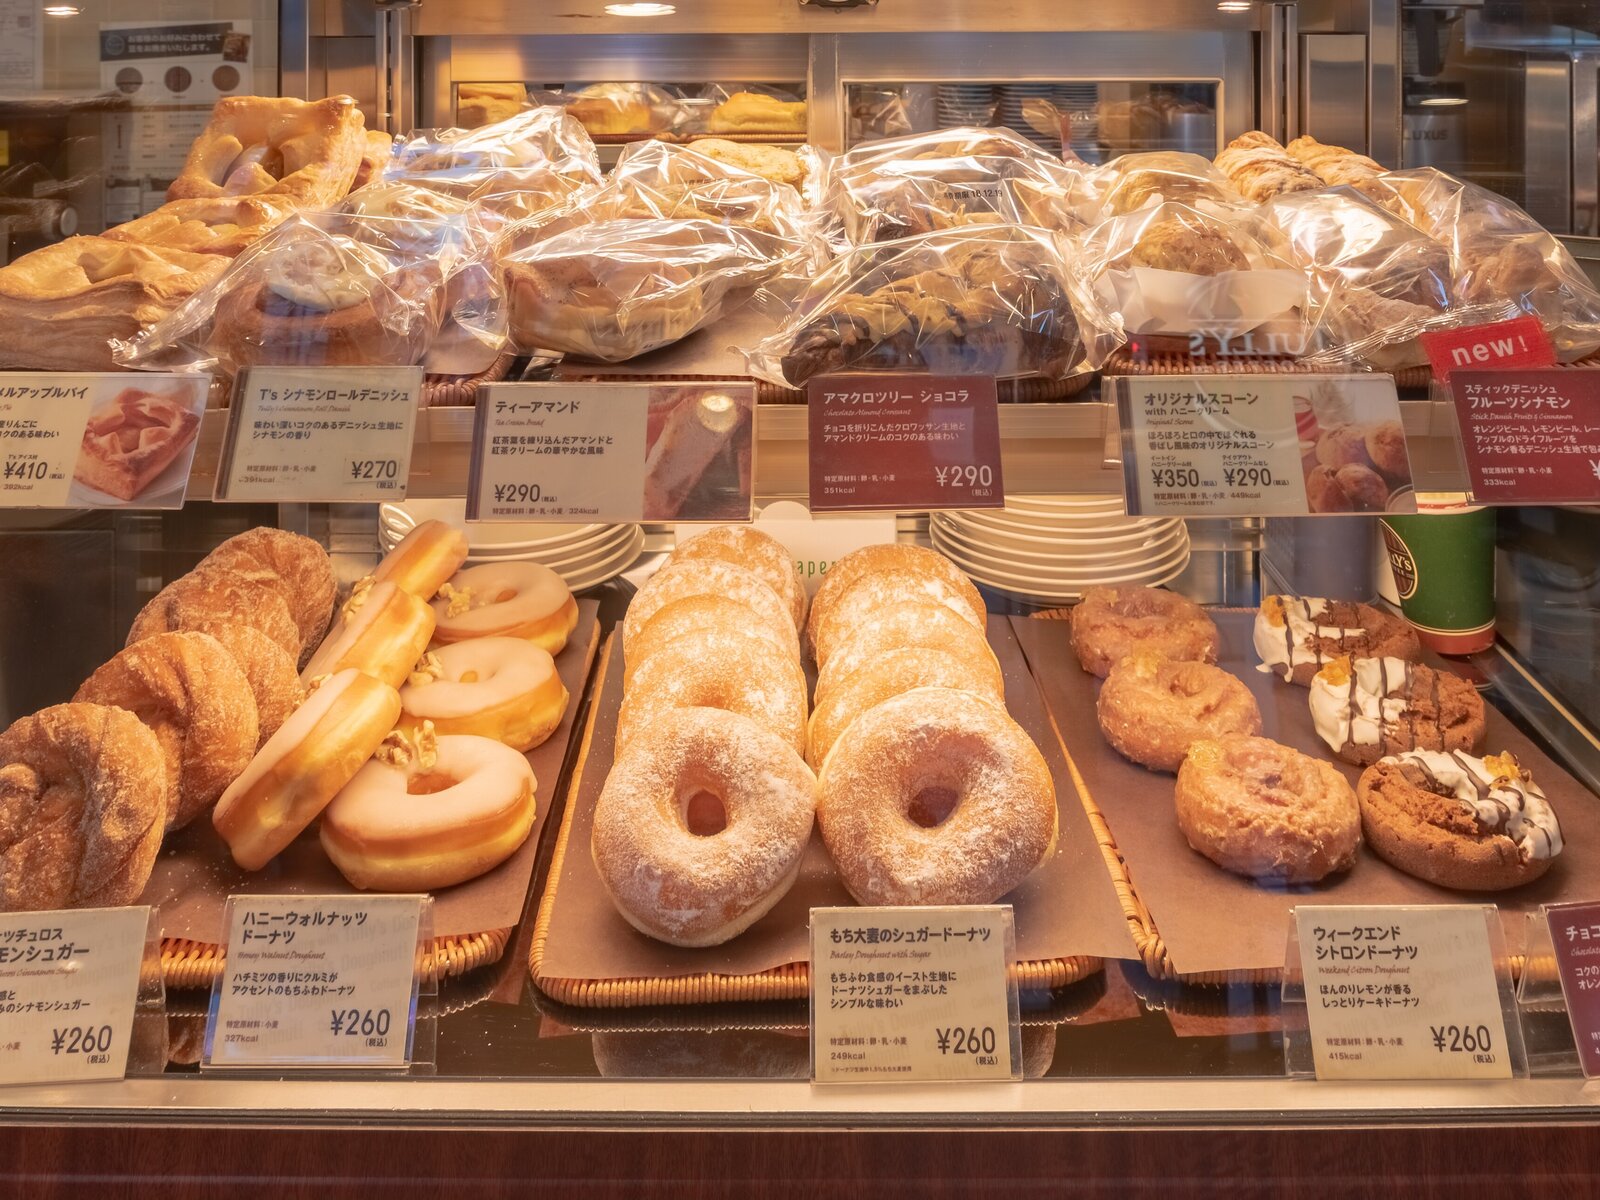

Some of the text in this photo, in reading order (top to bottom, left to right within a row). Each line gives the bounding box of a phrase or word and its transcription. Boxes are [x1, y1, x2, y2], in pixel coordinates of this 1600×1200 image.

[1451, 335, 1529, 366] new!
[260, 388, 410, 401] T's シナモンロールデニッシュ
[1465, 384, 1558, 394] スティックデニッシュ
[823, 390, 970, 405] アマクロツリー ショコラ
[1144, 393, 1259, 406] オリジナルスコーン
[1467, 396, 1571, 409] フルーツシナモン
[495, 401, 580, 414] ティーアマンド
[254, 421, 404, 430] 味わい深いコクのあるデニッシュ生地に
[0, 430, 60, 439] クのある味わい
[252, 431, 311, 440] シナモンの香り
[492, 436, 614, 445] 紅茶葉を練り込んだアマンドと
[823, 433, 960, 443] アマンドクリームのコクのある味わい
[491, 446, 605, 455] 紅茶クリームの華やかな風味
[3, 461, 48, 480] ¥410
[351, 460, 398, 479] ¥270
[934, 465, 993, 487] ¥290
[1151, 469, 1200, 488] ¥350
[1223, 468, 1272, 487] ¥290
[1483, 478, 1517, 486] 333kcal
[494, 484, 541, 503] ¥290
[242, 911, 368, 927] ハニーウォルナッツ
[0, 928, 63, 943] ツチュロス
[242, 929, 296, 945] ドーナツ
[829, 927, 991, 944] もち大麦のシュガードーナツ
[1313, 926, 1401, 941] ウィークエンド
[1315, 945, 1418, 961] シトロンドーナツ
[232, 972, 338, 983] ハチミツの香りにクルミが
[830, 971, 957, 983] もちふわ食感のイースト生地に
[231, 985, 356, 996] アクセントのもちふわドーナツ
[831, 985, 948, 996] ドーナツシュガーをまぶした
[1319, 984, 1412, 995] ほんのりレモンが香る
[830, 998, 904, 1009] シンプルな味わい
[1322, 997, 1420, 1008] しっとりケーキドーナツ
[330, 1008, 391, 1036] ¥260
[51, 1025, 113, 1055] ¥260
[224, 1034, 259, 1043] 327kcal
[936, 1026, 996, 1055] ¥260
[1430, 1025, 1492, 1053] ¥260
[830, 1052, 866, 1061] 249kcal
[1329, 1051, 1362, 1060] 415kcal
